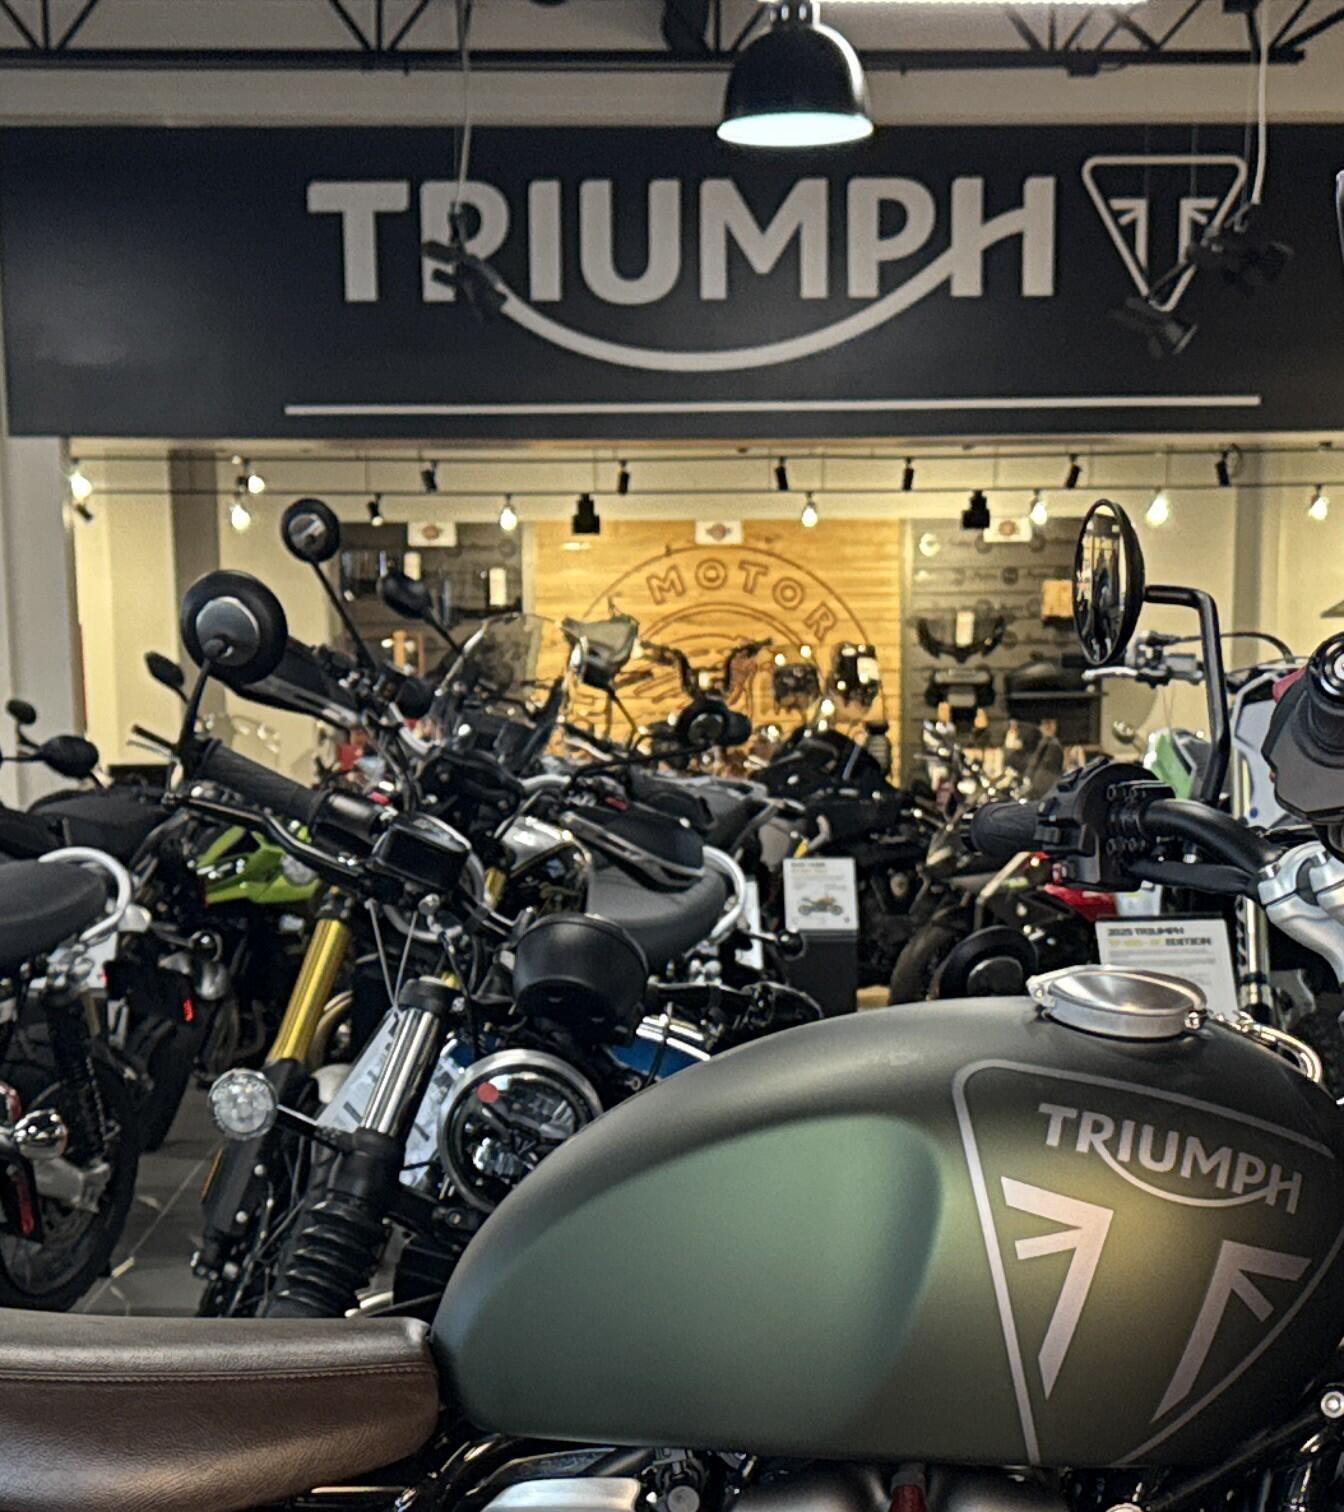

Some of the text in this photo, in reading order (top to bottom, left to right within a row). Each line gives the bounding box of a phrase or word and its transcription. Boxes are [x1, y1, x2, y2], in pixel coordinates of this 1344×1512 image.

[307, 177, 1054, 371] TRIUMPH
[646, 557, 838, 643] MOTOR
[1038, 1102, 1304, 1215] TRIUMPH
